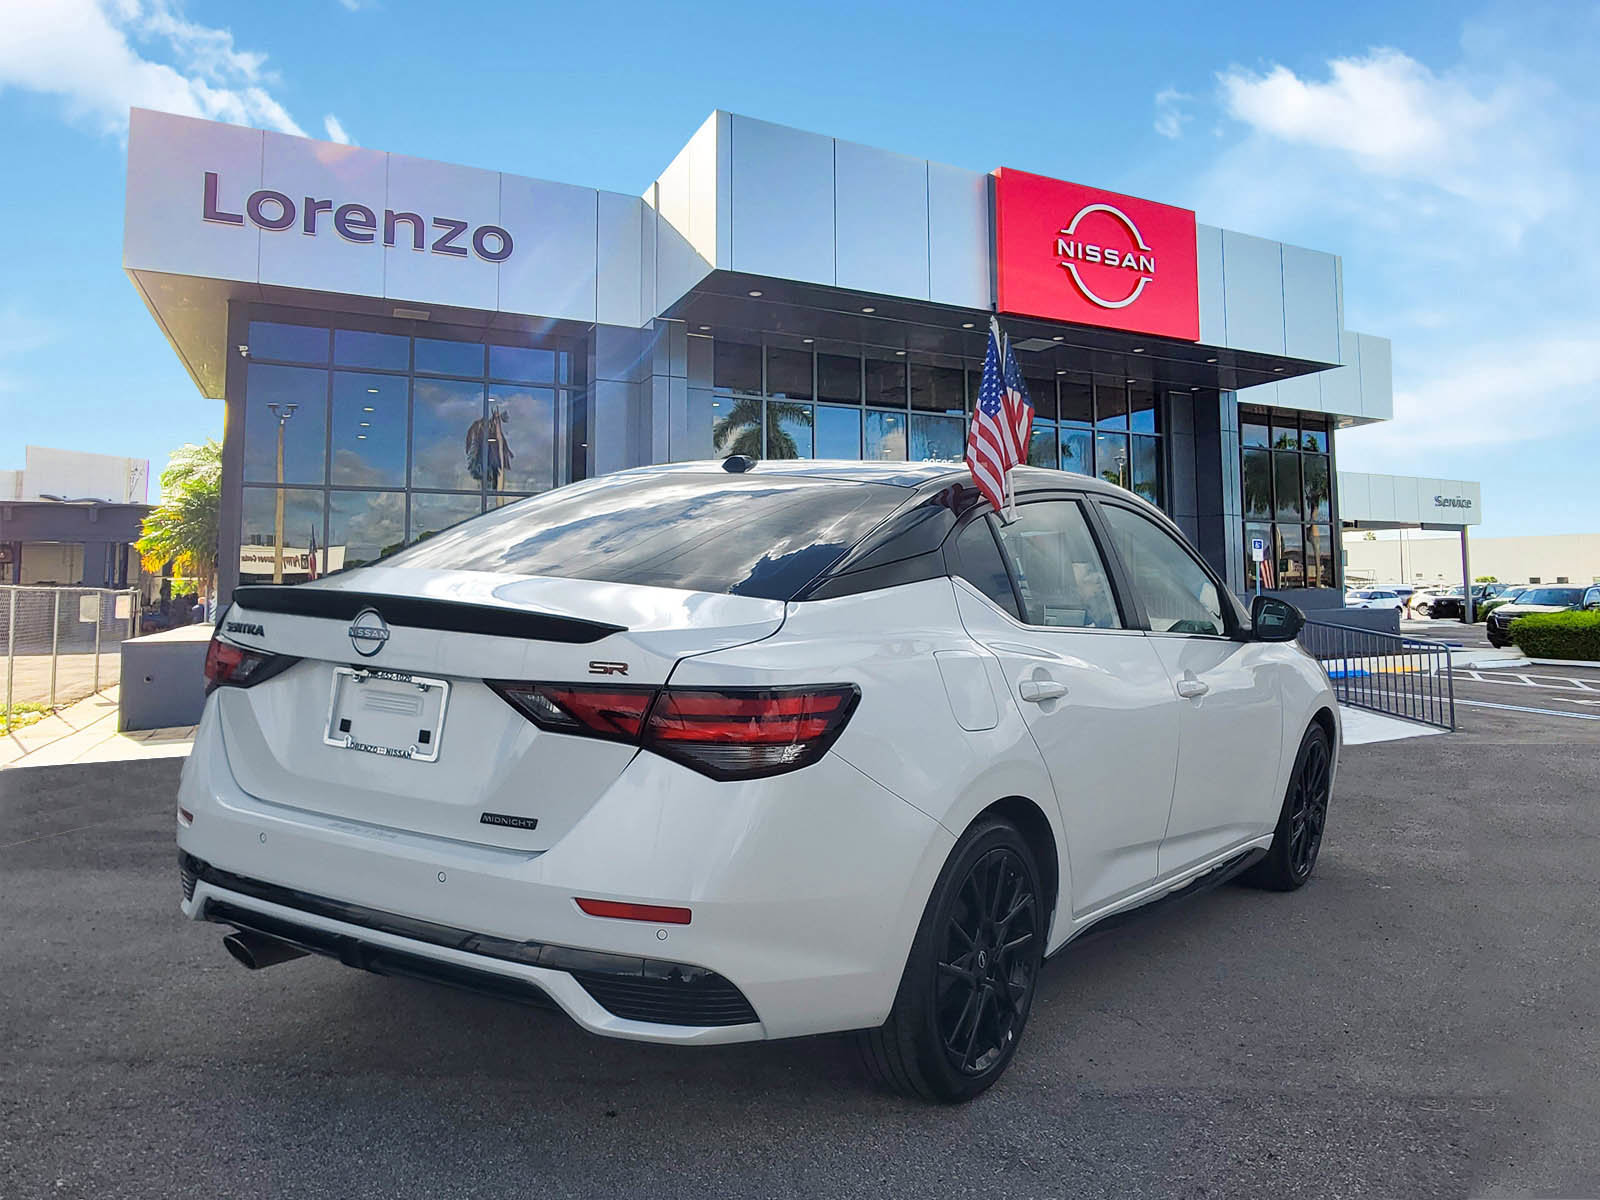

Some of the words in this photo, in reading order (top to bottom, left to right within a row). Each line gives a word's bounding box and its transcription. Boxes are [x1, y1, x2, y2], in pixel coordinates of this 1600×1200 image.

[203, 171, 514, 263] Lorenzo
[1057, 238, 1155, 273] NISSAN
[1434, 495, 1472, 508] Service
[588, 661, 629, 676] SR
[482, 814, 535, 828] MIDNIGHT
